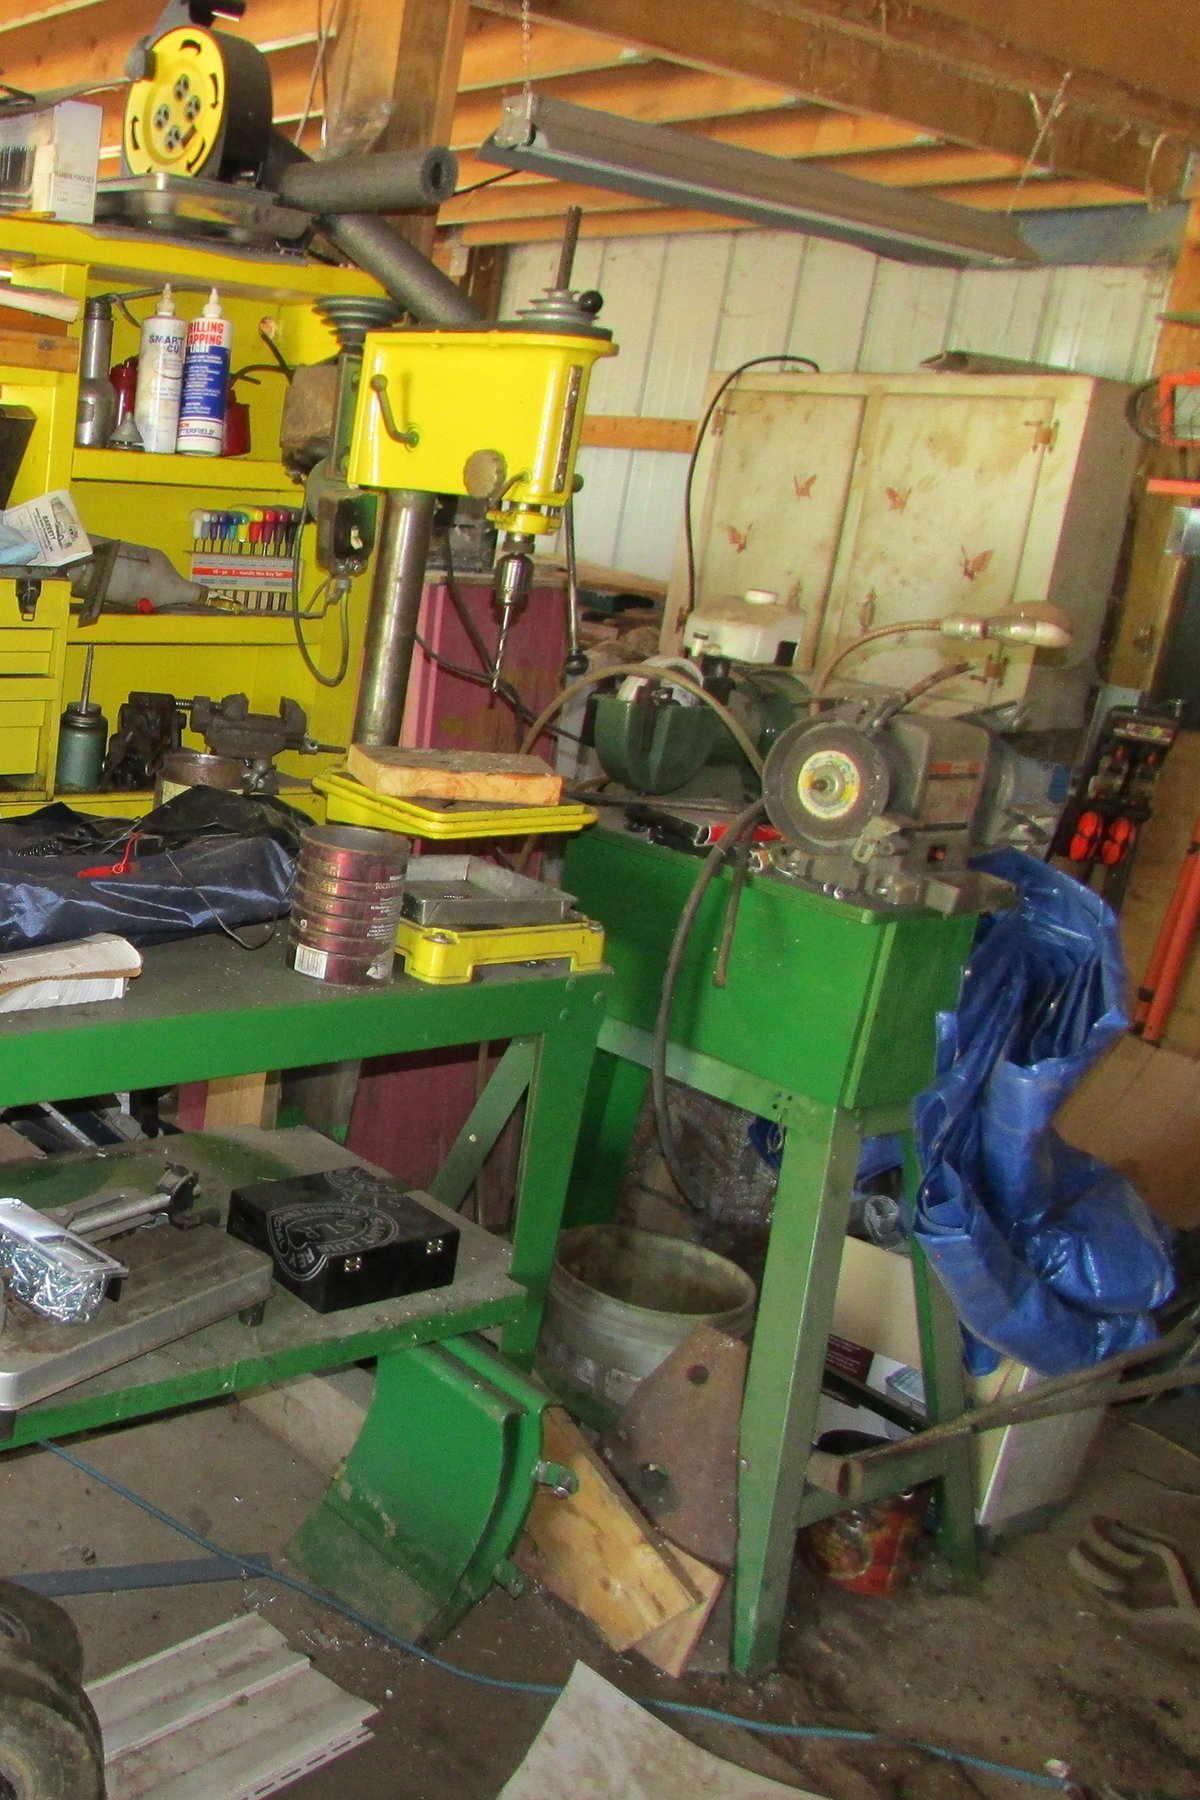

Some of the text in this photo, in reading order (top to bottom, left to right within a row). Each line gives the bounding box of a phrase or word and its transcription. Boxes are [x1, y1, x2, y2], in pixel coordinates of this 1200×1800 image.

[188, 321, 224, 334] RILLING
[148, 334, 184, 345] SMART
[187, 332, 222, 345] APPING
[179, 427, 215, 436] TTERFIELD
